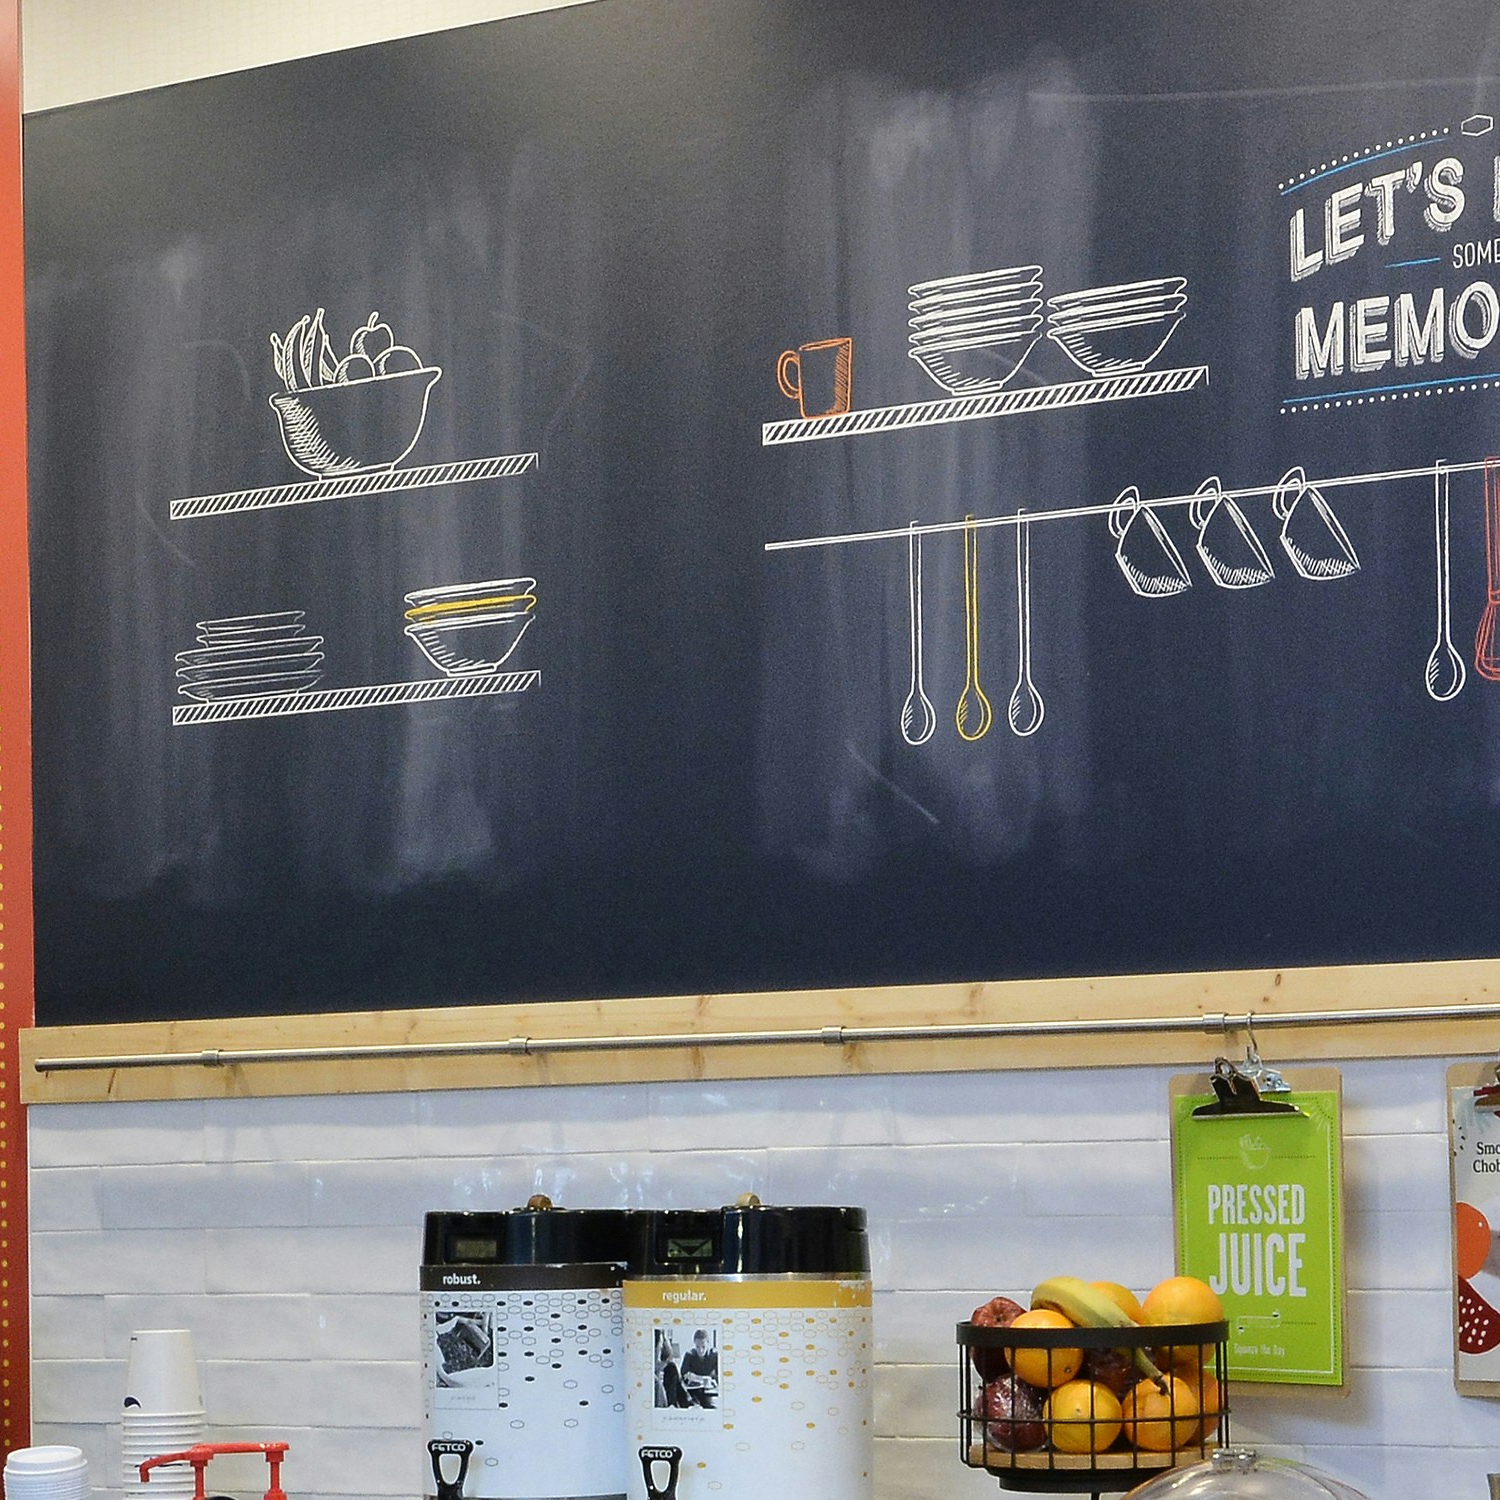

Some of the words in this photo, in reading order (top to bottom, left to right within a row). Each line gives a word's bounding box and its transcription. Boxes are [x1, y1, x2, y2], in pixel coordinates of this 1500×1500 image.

[1289, 157, 1466, 282] LET'S
[1208, 1184, 1306, 1226] PRESSED
[443, 1272, 481, 1285] robust.
[1208, 1233, 1307, 1298] JUICE
[662, 1290, 707, 1303] regular.
[641, 1449, 673, 1459] FETCO
